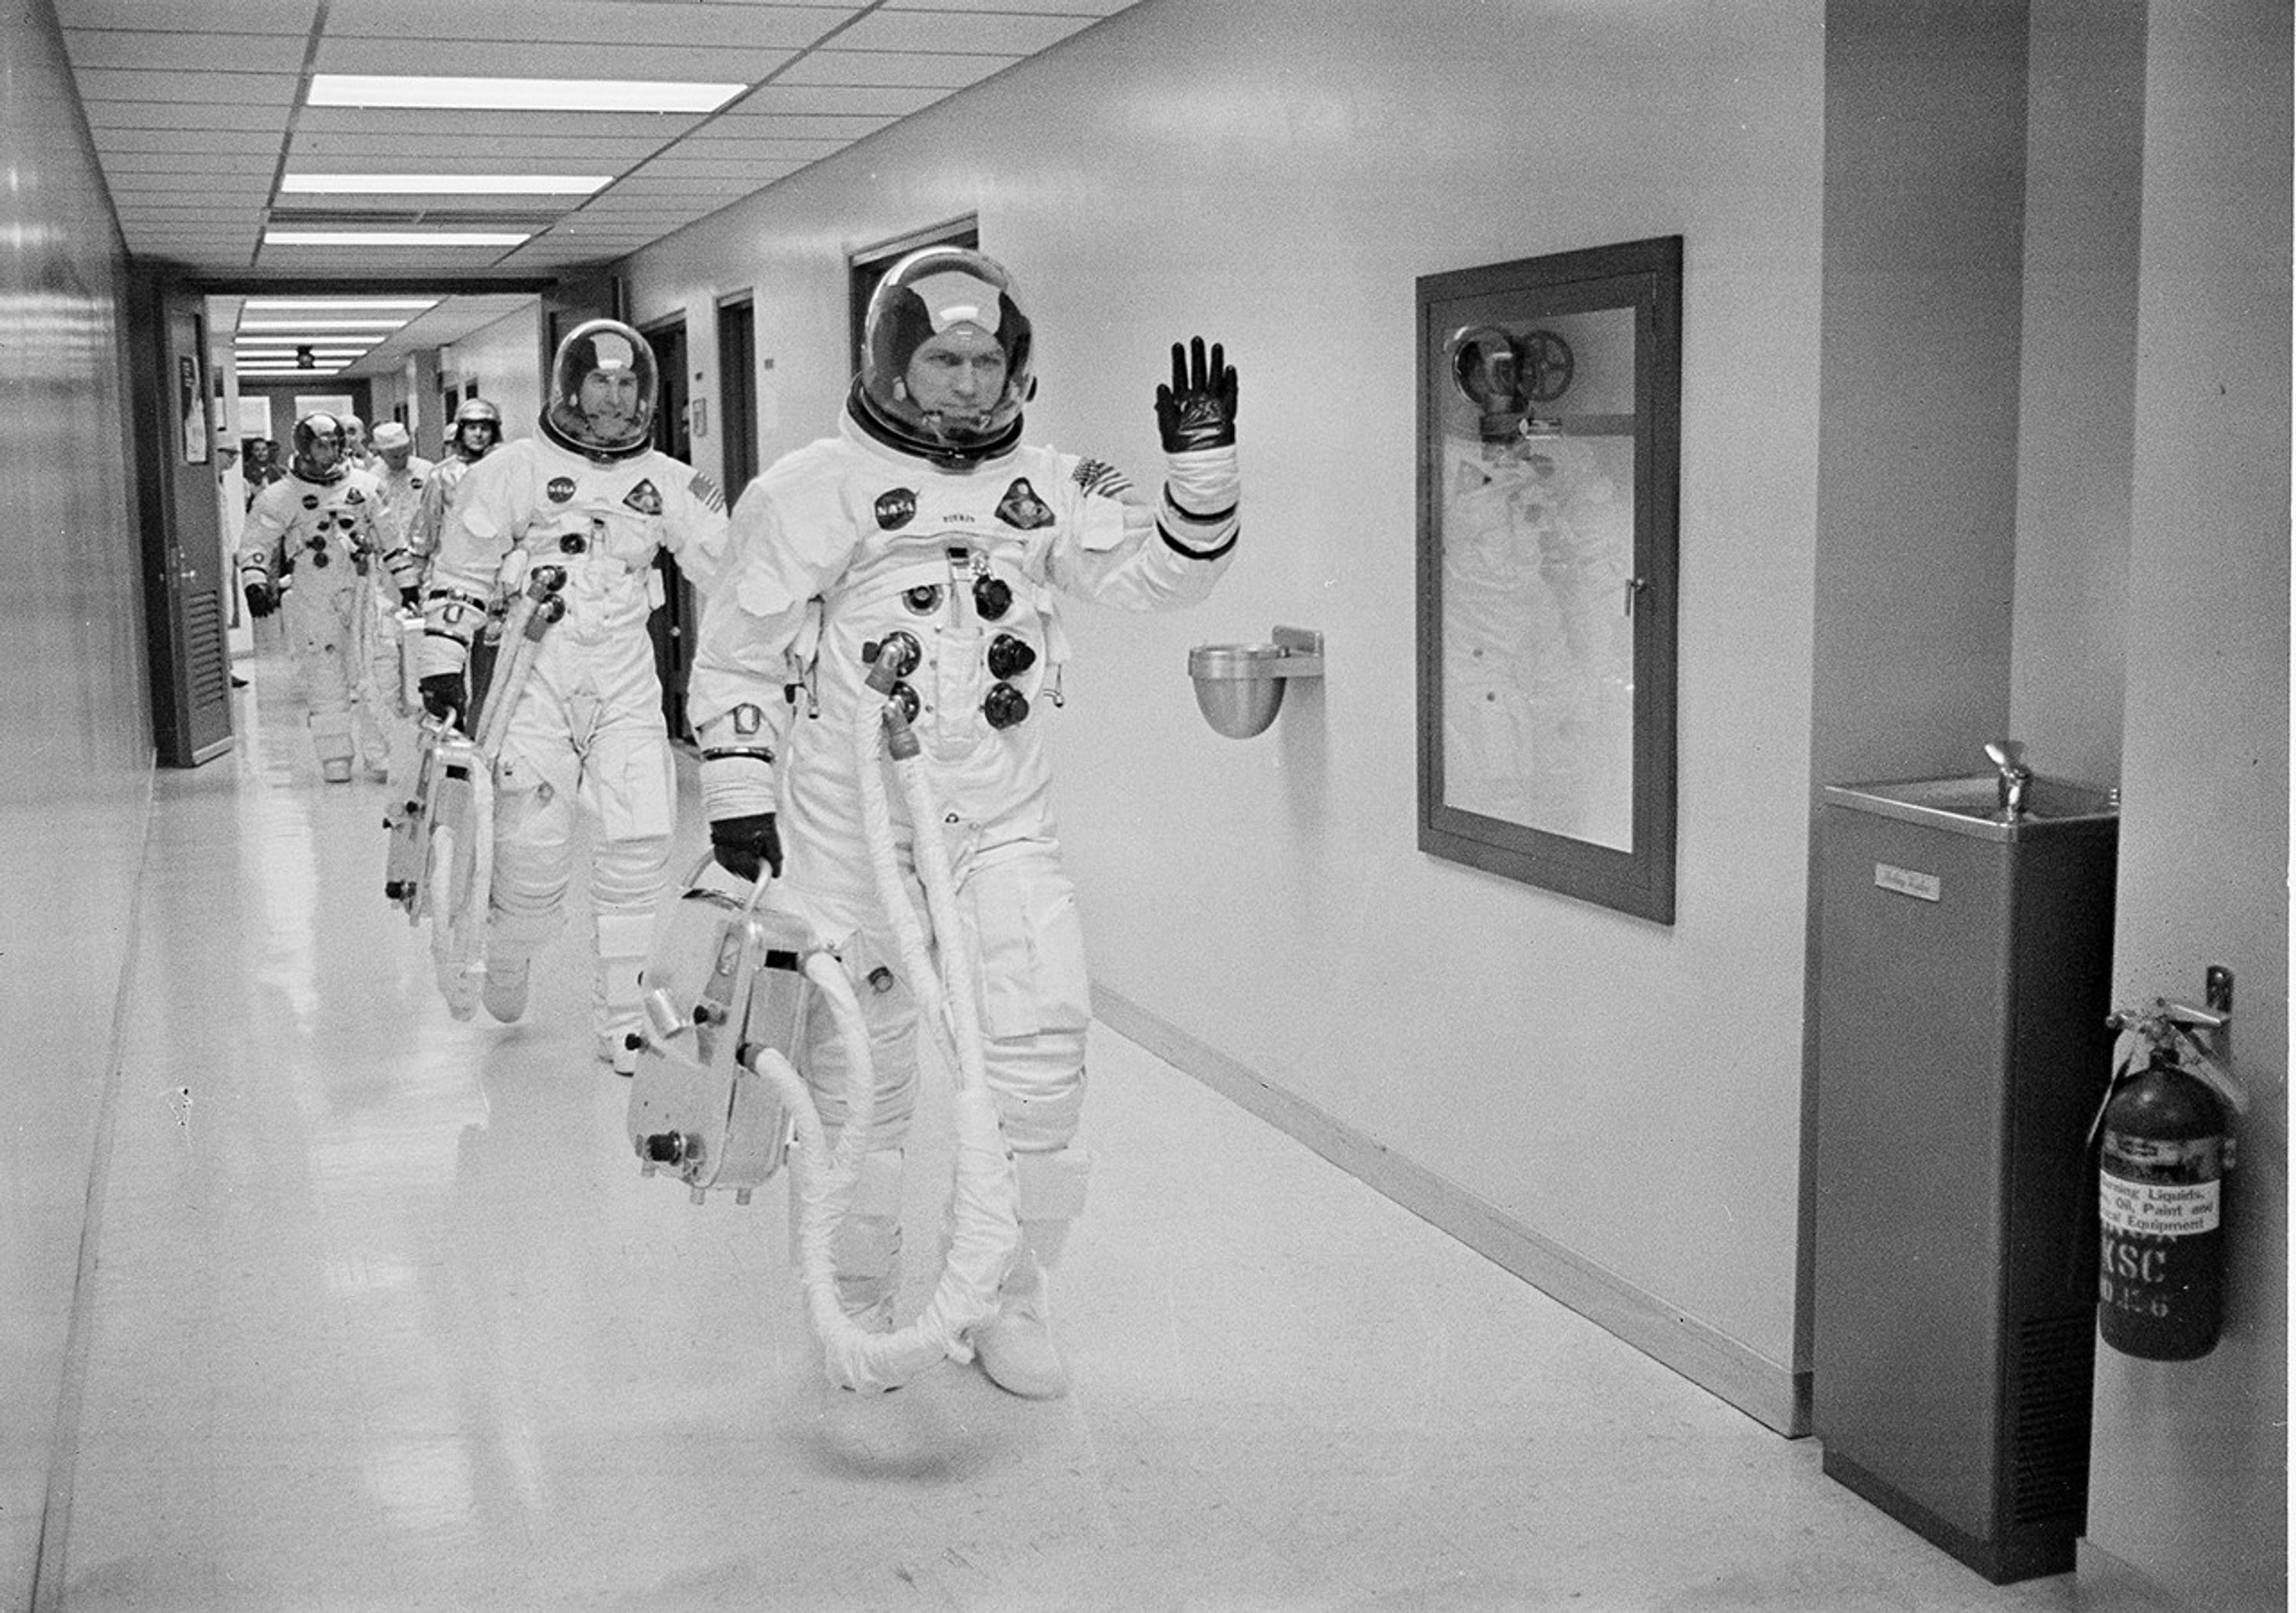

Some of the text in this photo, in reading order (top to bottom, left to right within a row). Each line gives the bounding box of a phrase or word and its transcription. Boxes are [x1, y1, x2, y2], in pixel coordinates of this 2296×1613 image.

[877, 500, 915, 516] NASA
[2143, 1203, 2183, 1216] Paint
[2128, 1216, 2204, 1233] Equipment
